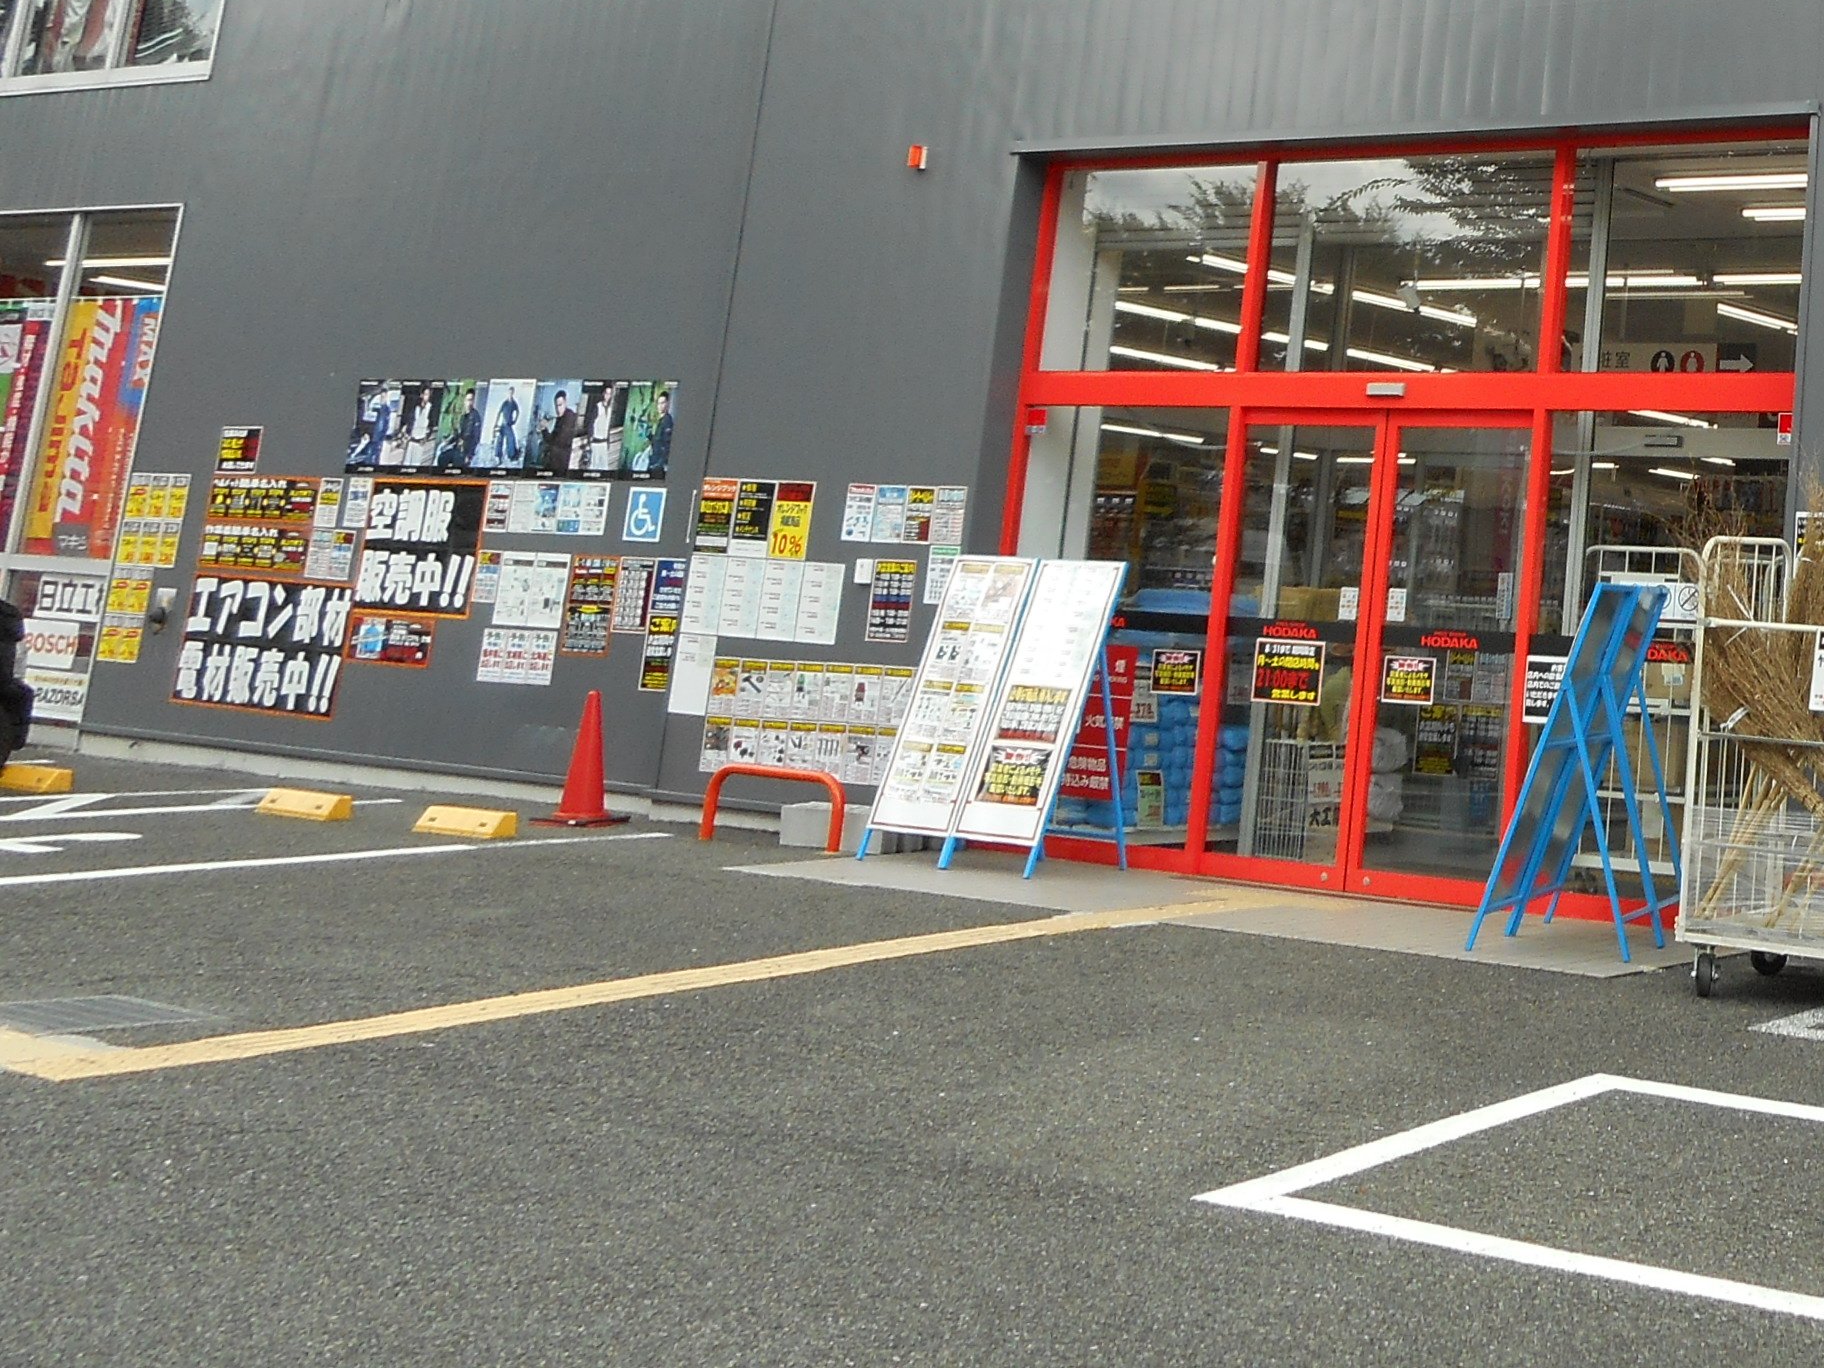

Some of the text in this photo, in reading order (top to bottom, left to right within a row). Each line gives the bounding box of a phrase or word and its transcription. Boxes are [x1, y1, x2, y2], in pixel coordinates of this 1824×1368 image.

[53, 300, 123, 522] makita
[371, 489, 455, 543] 空調服
[355, 549, 475, 608] 販売中!!
[187, 576, 352, 647] エアコン部材
[1263, 626, 1317, 639] HODAKA
[1421, 636, 1478, 649] HODAKA
[176, 640, 342, 714] 電材販売中!!
